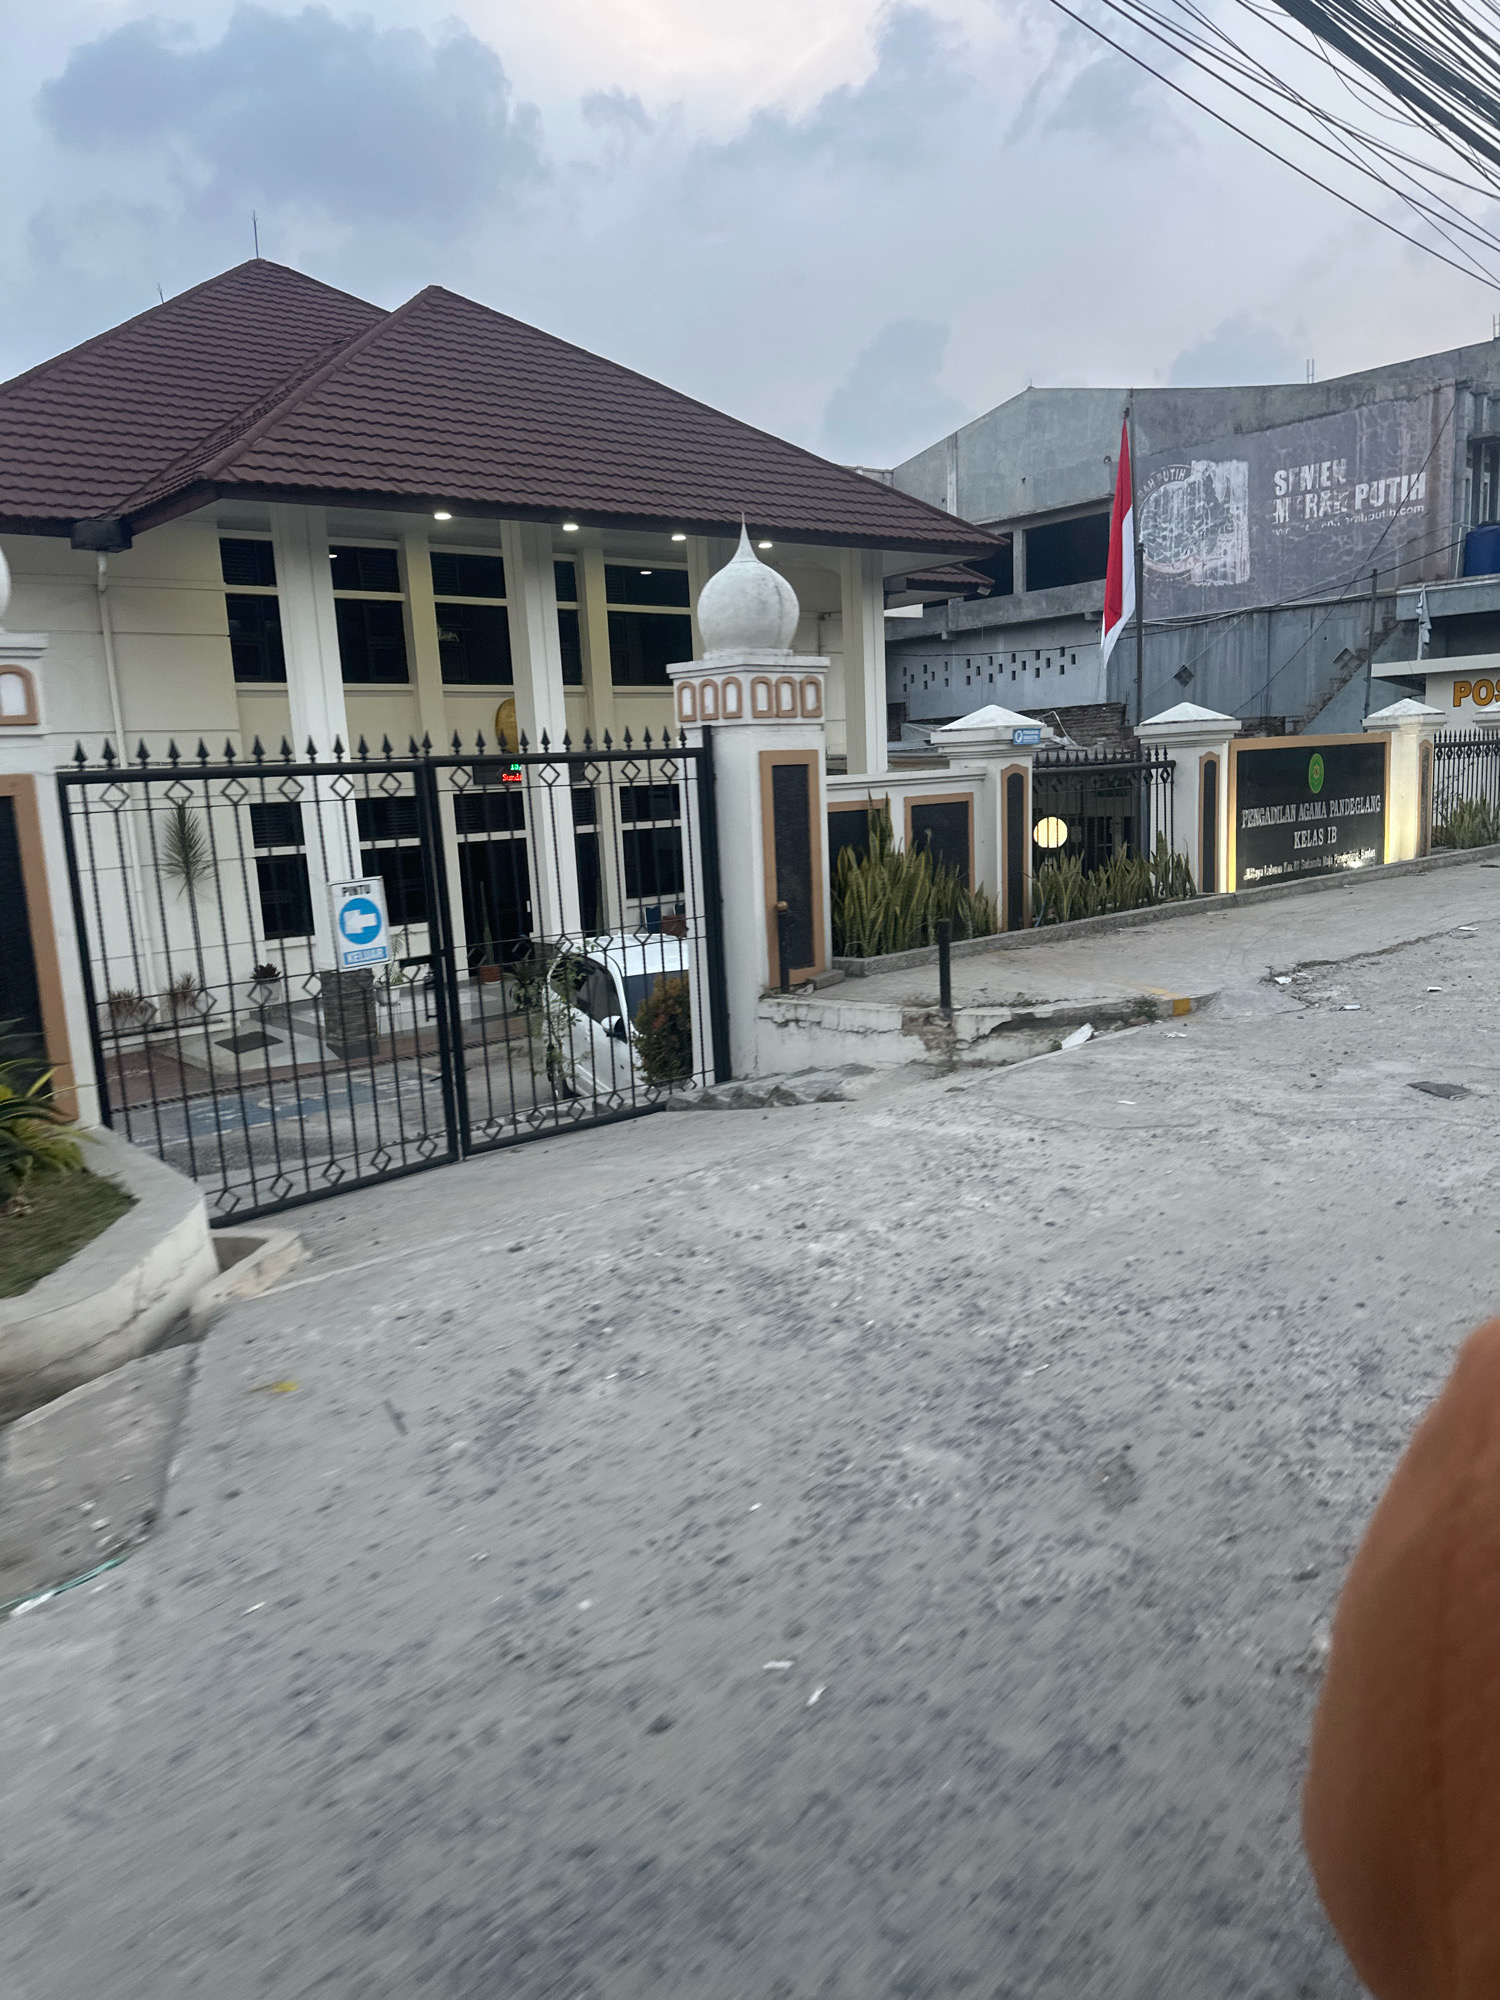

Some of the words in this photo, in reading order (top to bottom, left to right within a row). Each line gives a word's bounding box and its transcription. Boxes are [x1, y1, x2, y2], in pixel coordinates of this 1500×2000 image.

[1354, 471, 1427, 511] PUTIH
[1452, 678, 1500, 708] PO
[1241, 804, 1297, 828] PENGADILAN
[1297, 801, 1328, 822] AGAMA
[1329, 795, 1381, 817] PANDEGLANG
[1294, 828, 1324, 849] KELAS
[1327, 825, 1338, 844] IB
[342, 884, 371, 897] PINTU
[347, 948, 384, 962] KELUAR
